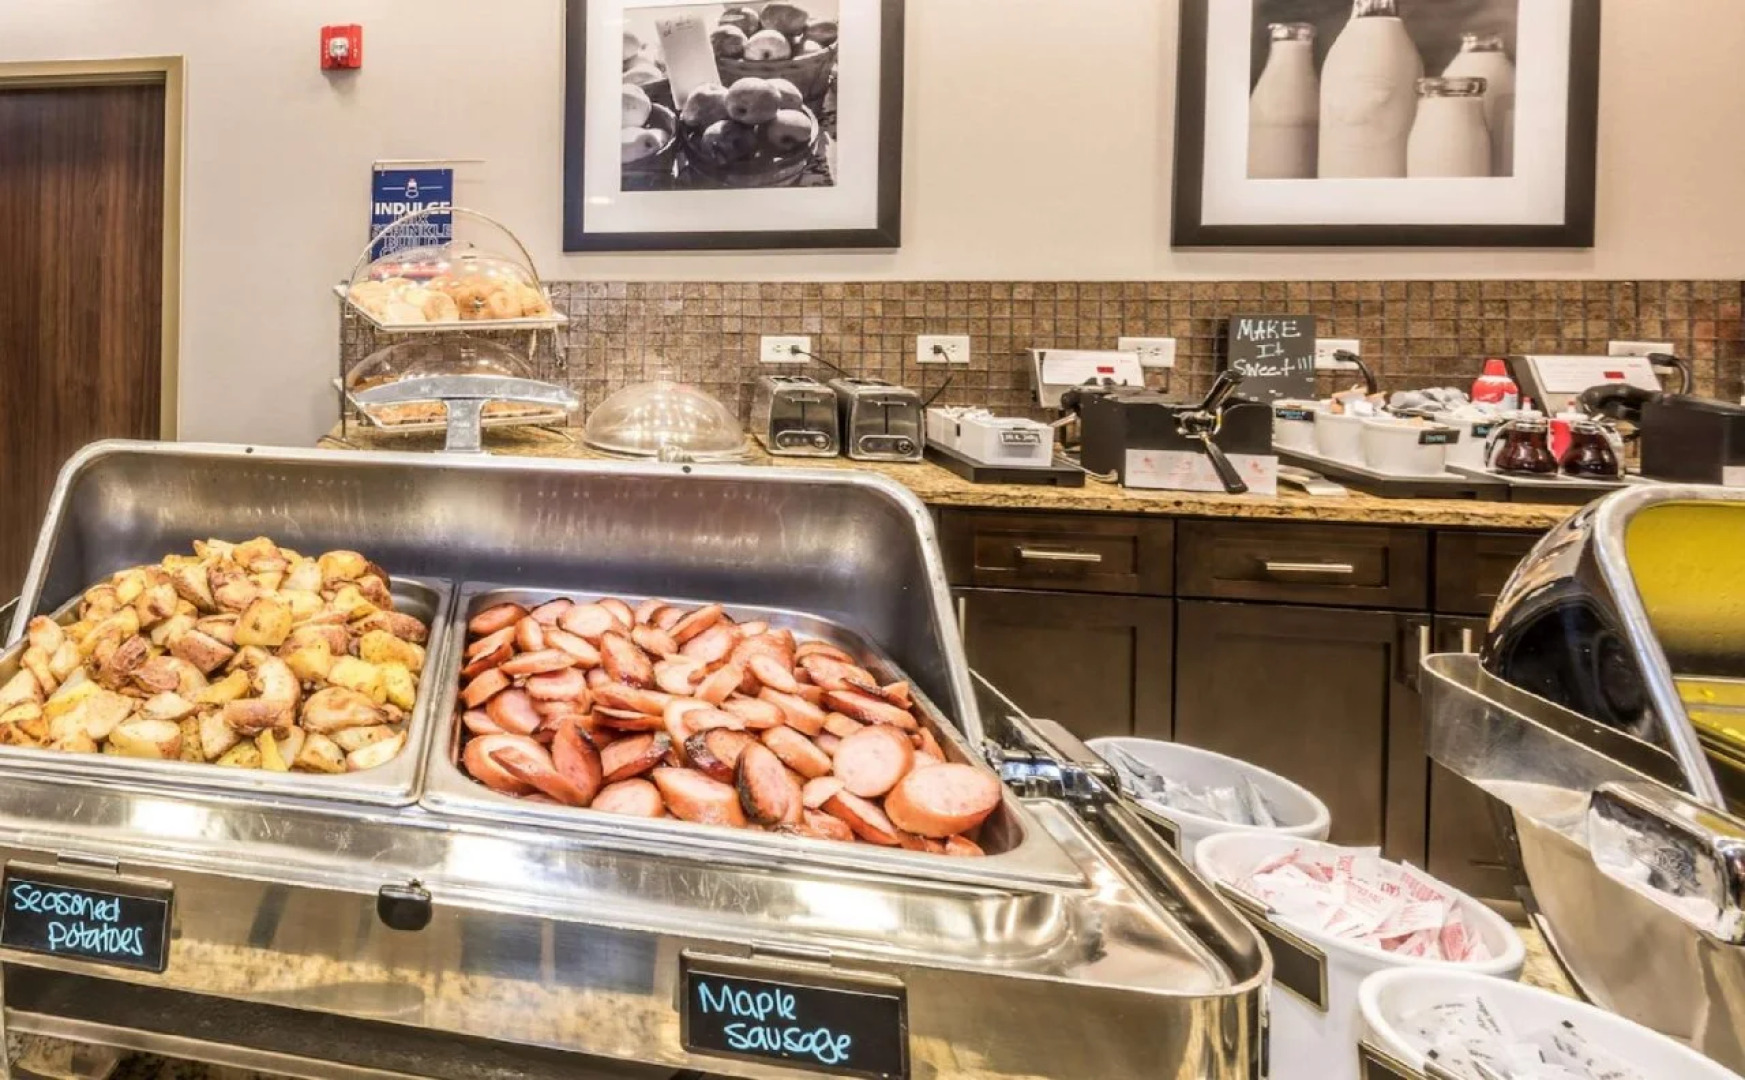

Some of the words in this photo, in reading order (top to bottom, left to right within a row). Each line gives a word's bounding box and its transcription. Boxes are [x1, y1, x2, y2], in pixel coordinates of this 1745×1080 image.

[1236, 318, 1302, 342] MAKE
[1255, 341, 1285, 359] It
[12, 883, 121, 923] Seasoned
[48, 920, 144, 957] Potatoes
[697, 981, 797, 1021] Maple
